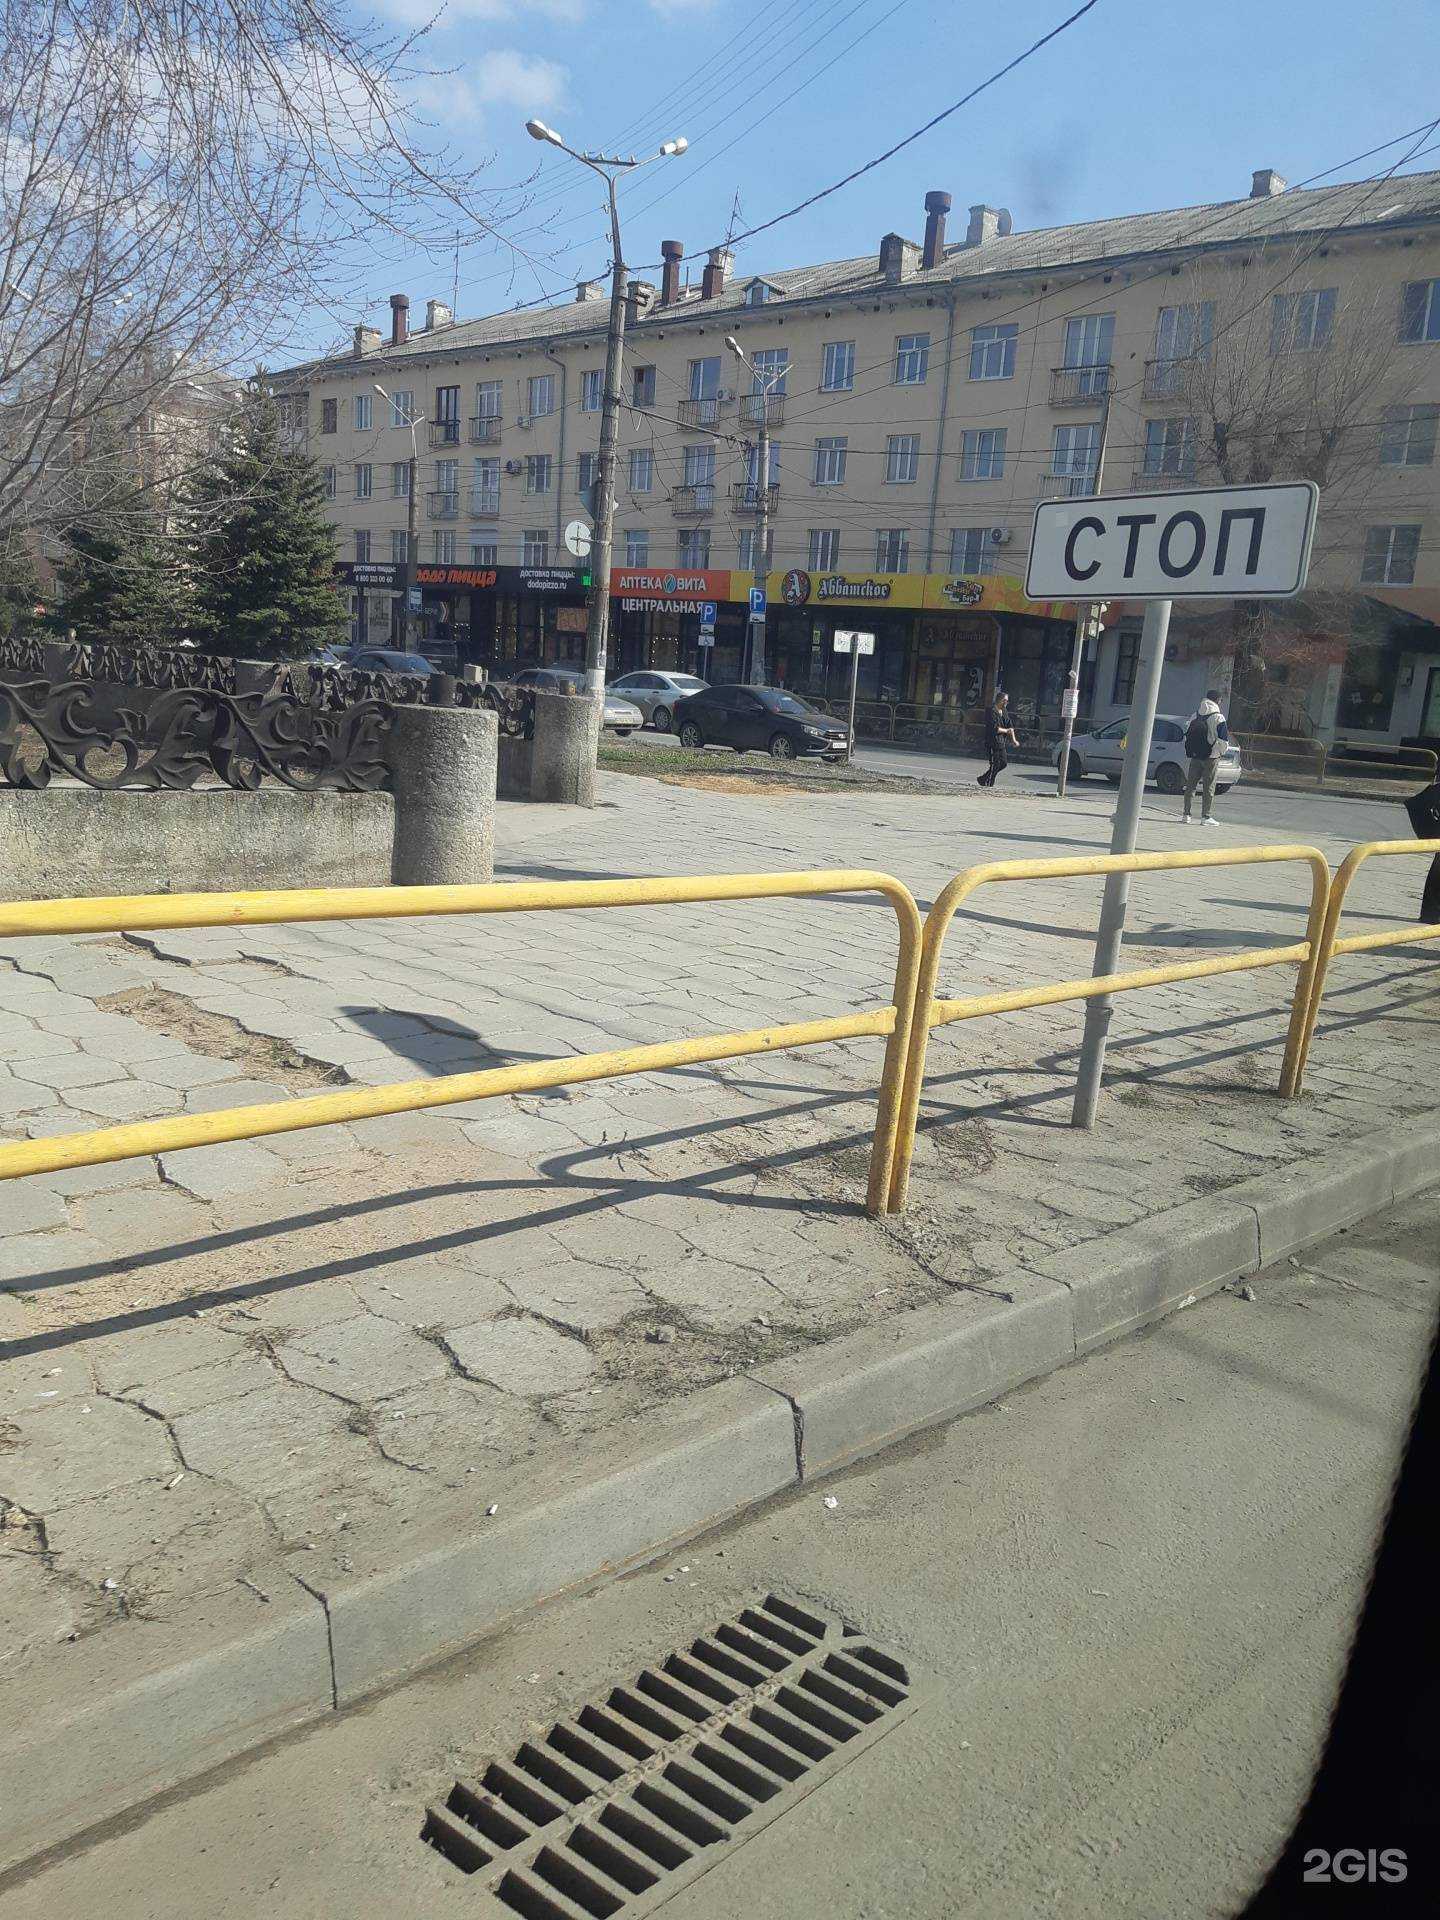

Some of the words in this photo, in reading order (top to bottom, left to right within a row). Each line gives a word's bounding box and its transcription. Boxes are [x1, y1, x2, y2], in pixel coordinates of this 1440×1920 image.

[1064, 507, 1266, 581] СТОП
[620, 576, 663, 590] АПТЕКА
[677, 577, 707, 591] ВИТА
[622, 598, 702, 614] ЦЕНТРАЛЬНАЯ
